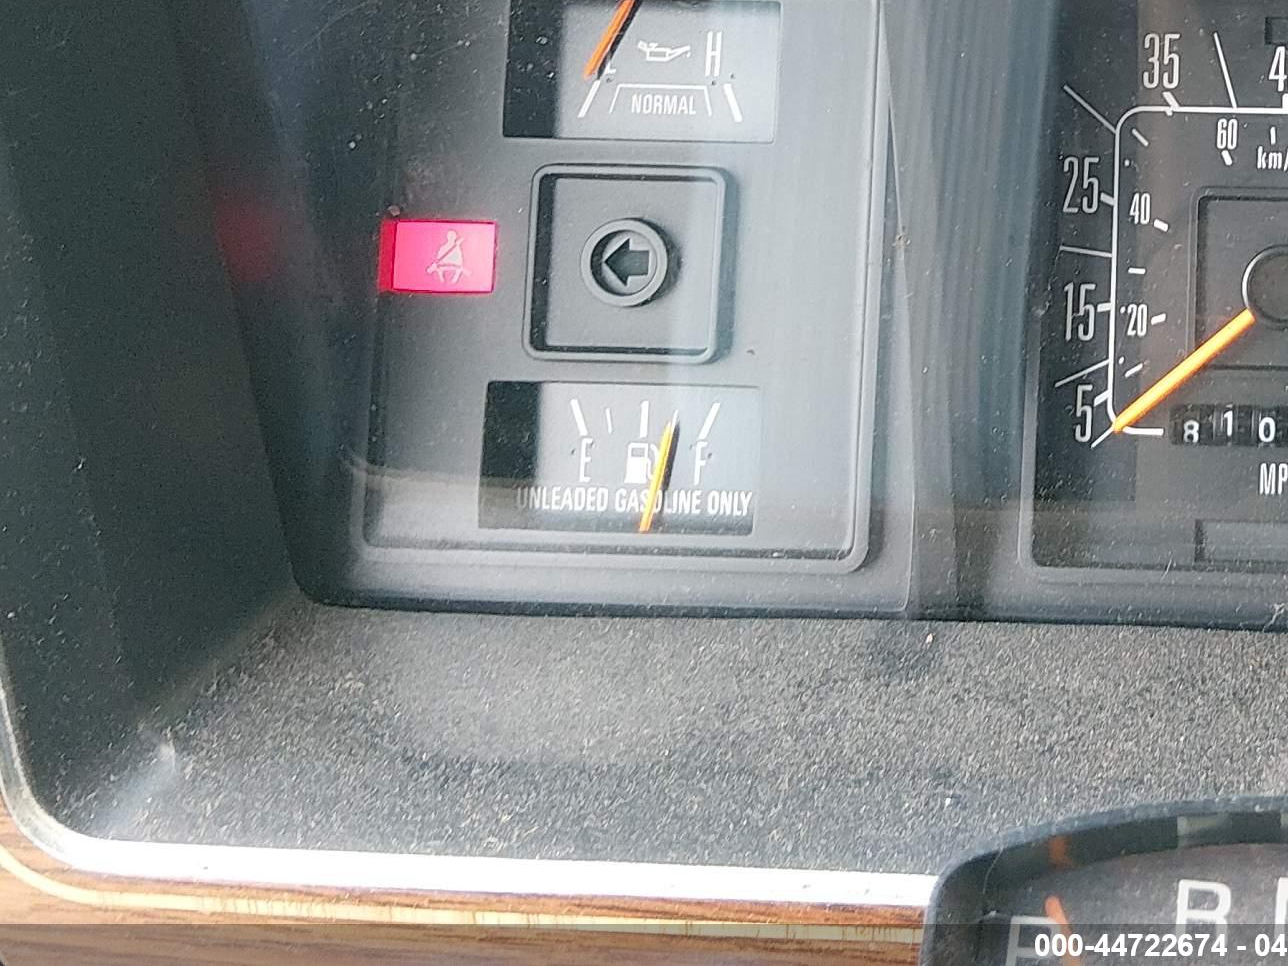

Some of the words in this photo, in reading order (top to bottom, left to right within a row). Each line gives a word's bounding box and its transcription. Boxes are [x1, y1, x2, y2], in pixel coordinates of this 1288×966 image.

[705, 31, 722, 76] H
[1143, 34, 1181, 89] 35
[631, 93, 697, 116] NORMAL
[1216, 120, 1238, 150] 60
[1063, 157, 1100, 214] 25
[1129, 194, 1151, 225] 40
[1064, 283, 1097, 342] 15
[1127, 305, 1148, 336] 20
[1074, 384, 1094, 442] 5
[580, 437, 593, 482] E
[693, 441, 709, 485] F
[516, 485, 609, 512] UNLEADED
[707, 490, 753, 516] ONLY
[1174, 879, 1232, 944] R
